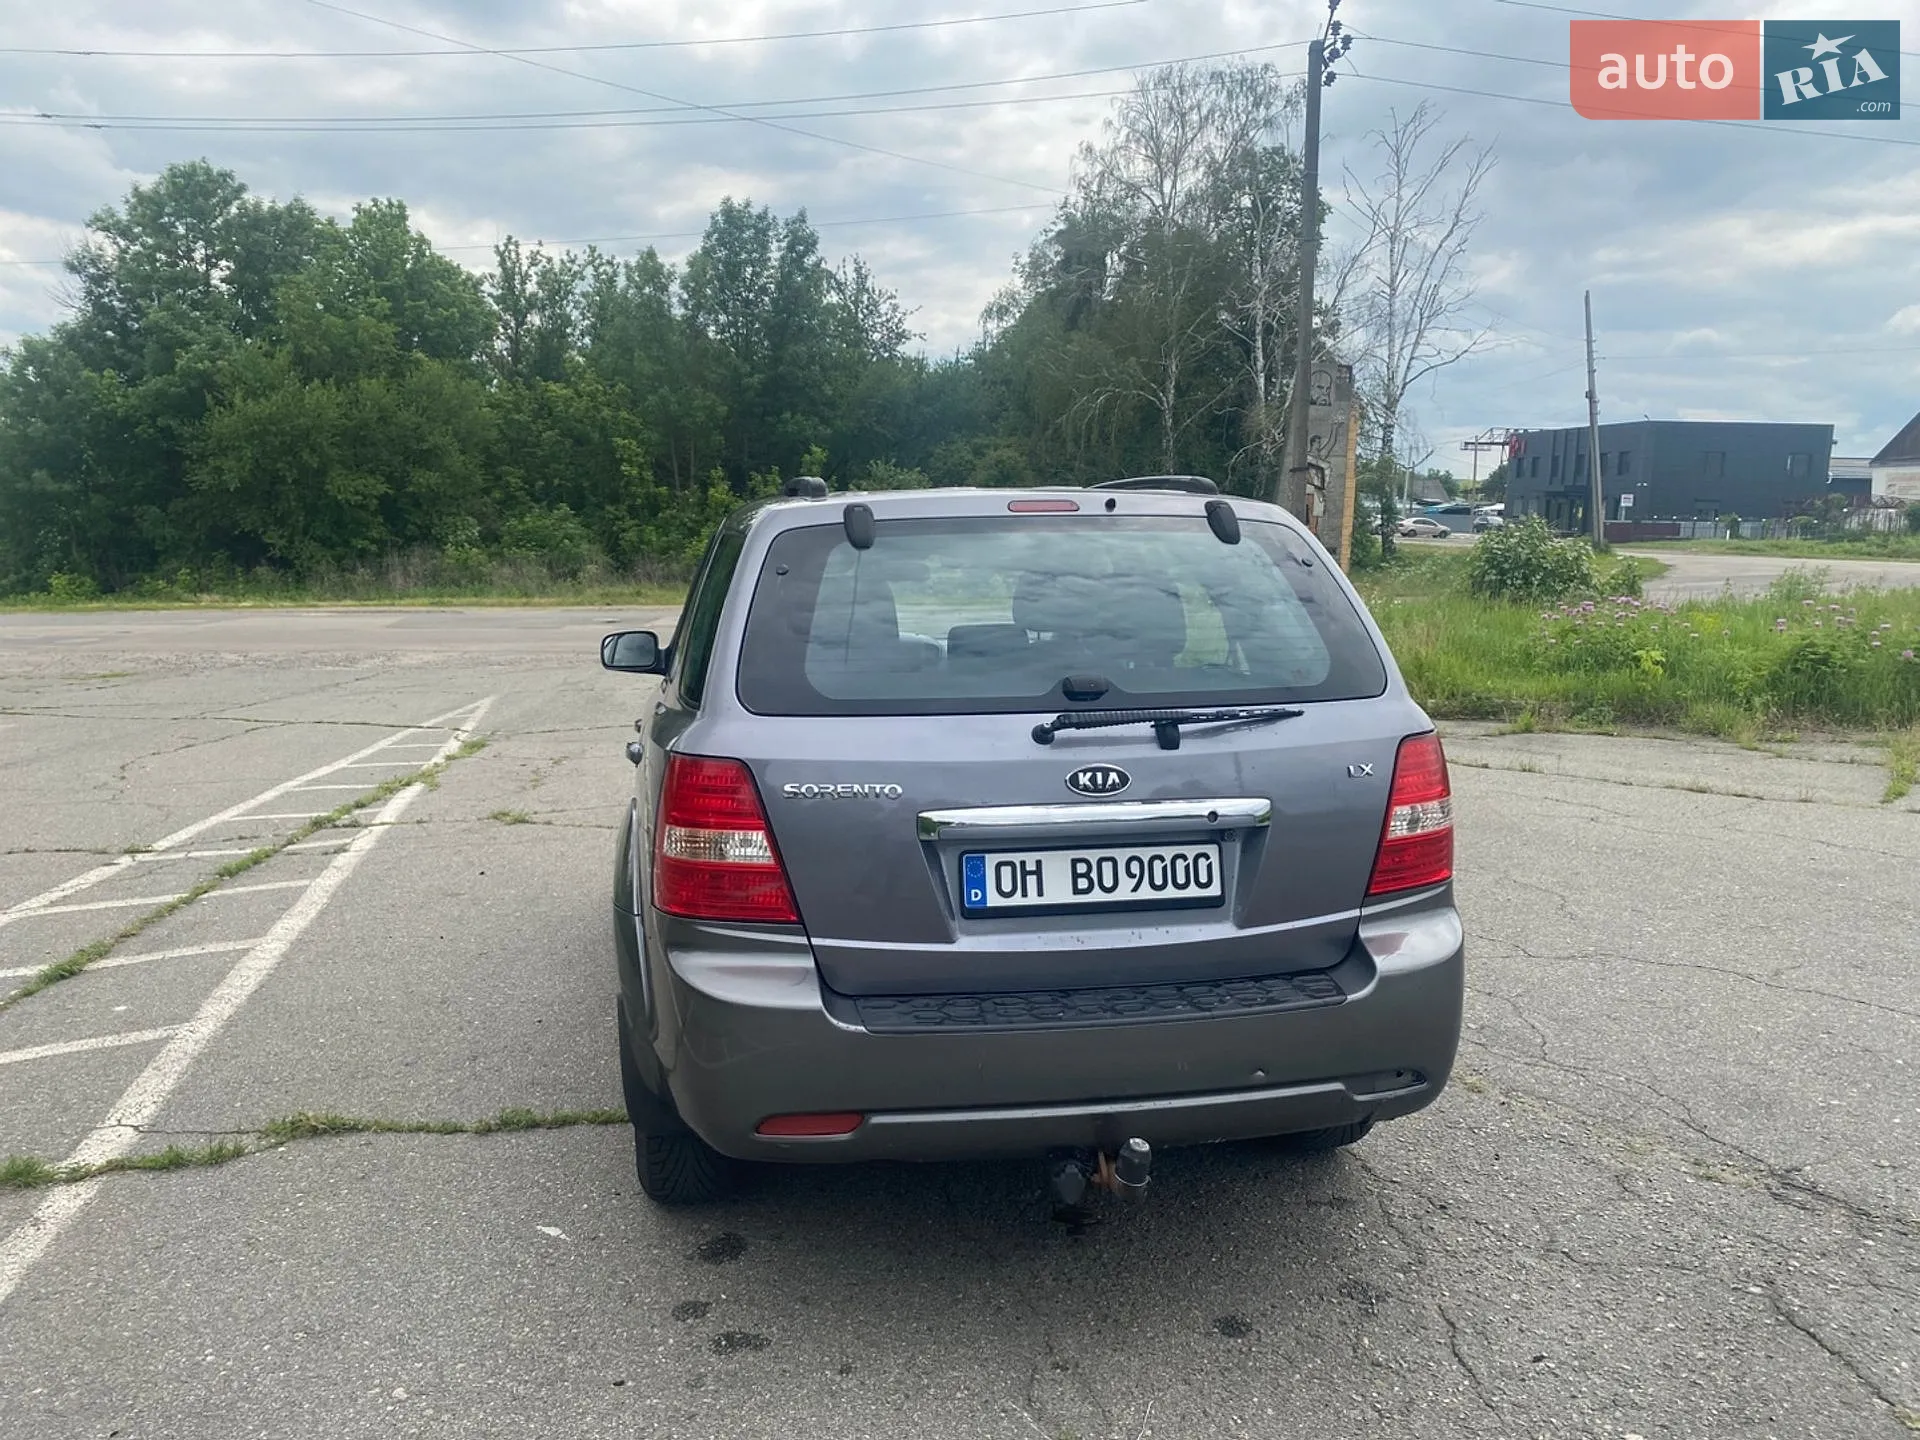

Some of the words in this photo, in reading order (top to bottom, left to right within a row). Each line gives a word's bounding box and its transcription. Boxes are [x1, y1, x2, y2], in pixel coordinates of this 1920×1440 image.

[1077, 771, 1121, 792] KIA
[782, 783, 903, 799] SORENTO
[994, 858, 1044, 899] OH
[971, 889, 982, 902] D
